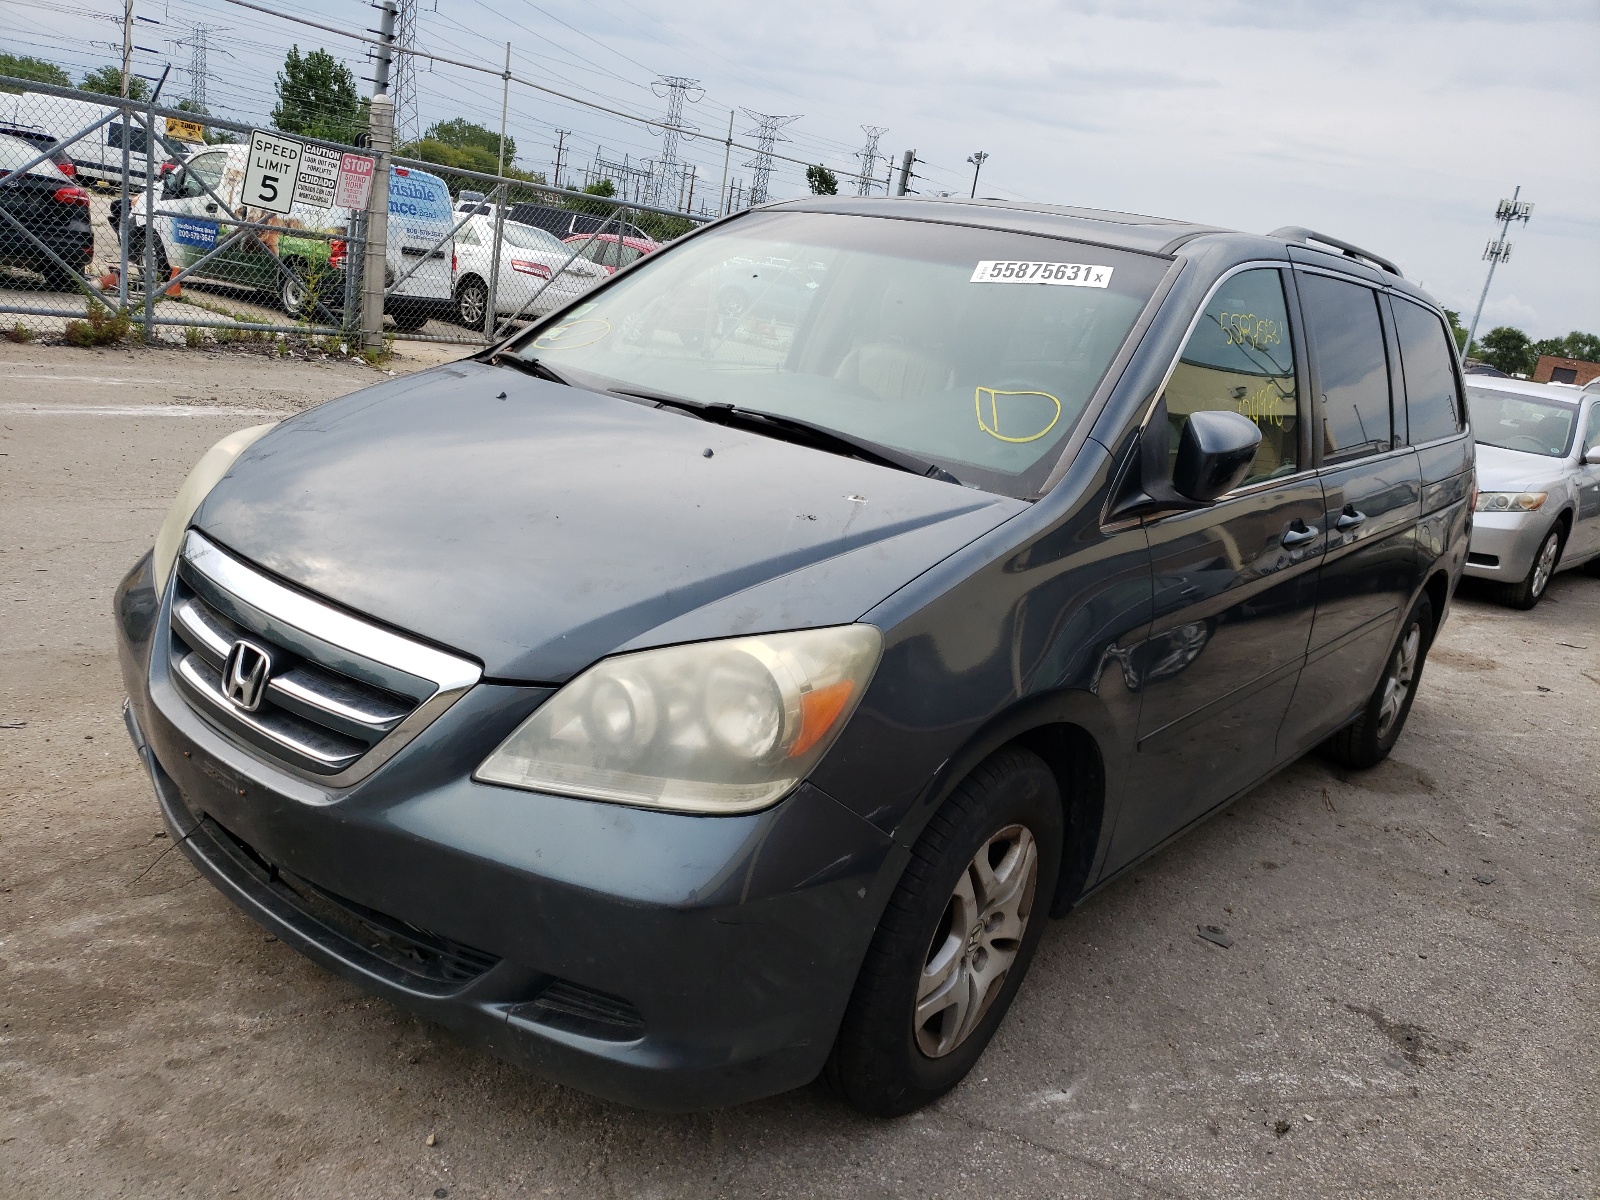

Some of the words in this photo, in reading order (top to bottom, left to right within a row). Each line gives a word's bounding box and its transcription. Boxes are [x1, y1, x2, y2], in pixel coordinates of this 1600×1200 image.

[255, 140, 298, 160] SPEED
[305, 144, 341, 161] CAUTION
[256, 157, 291, 175] LIMIT
[304, 156, 317, 165] LOOK
[317, 159, 327, 167] OUT
[327, 161, 338, 170] FOR
[307, 164, 333, 176] FORKLIFTS
[344, 158, 372, 173] STOP
[300, 174, 334, 188] CUIDADO
[345, 174, 366, 184] SOUND
[345, 181, 364, 189] HORN
[258, 175, 279, 203] 5
[989, 262, 1093, 282] 55875631
